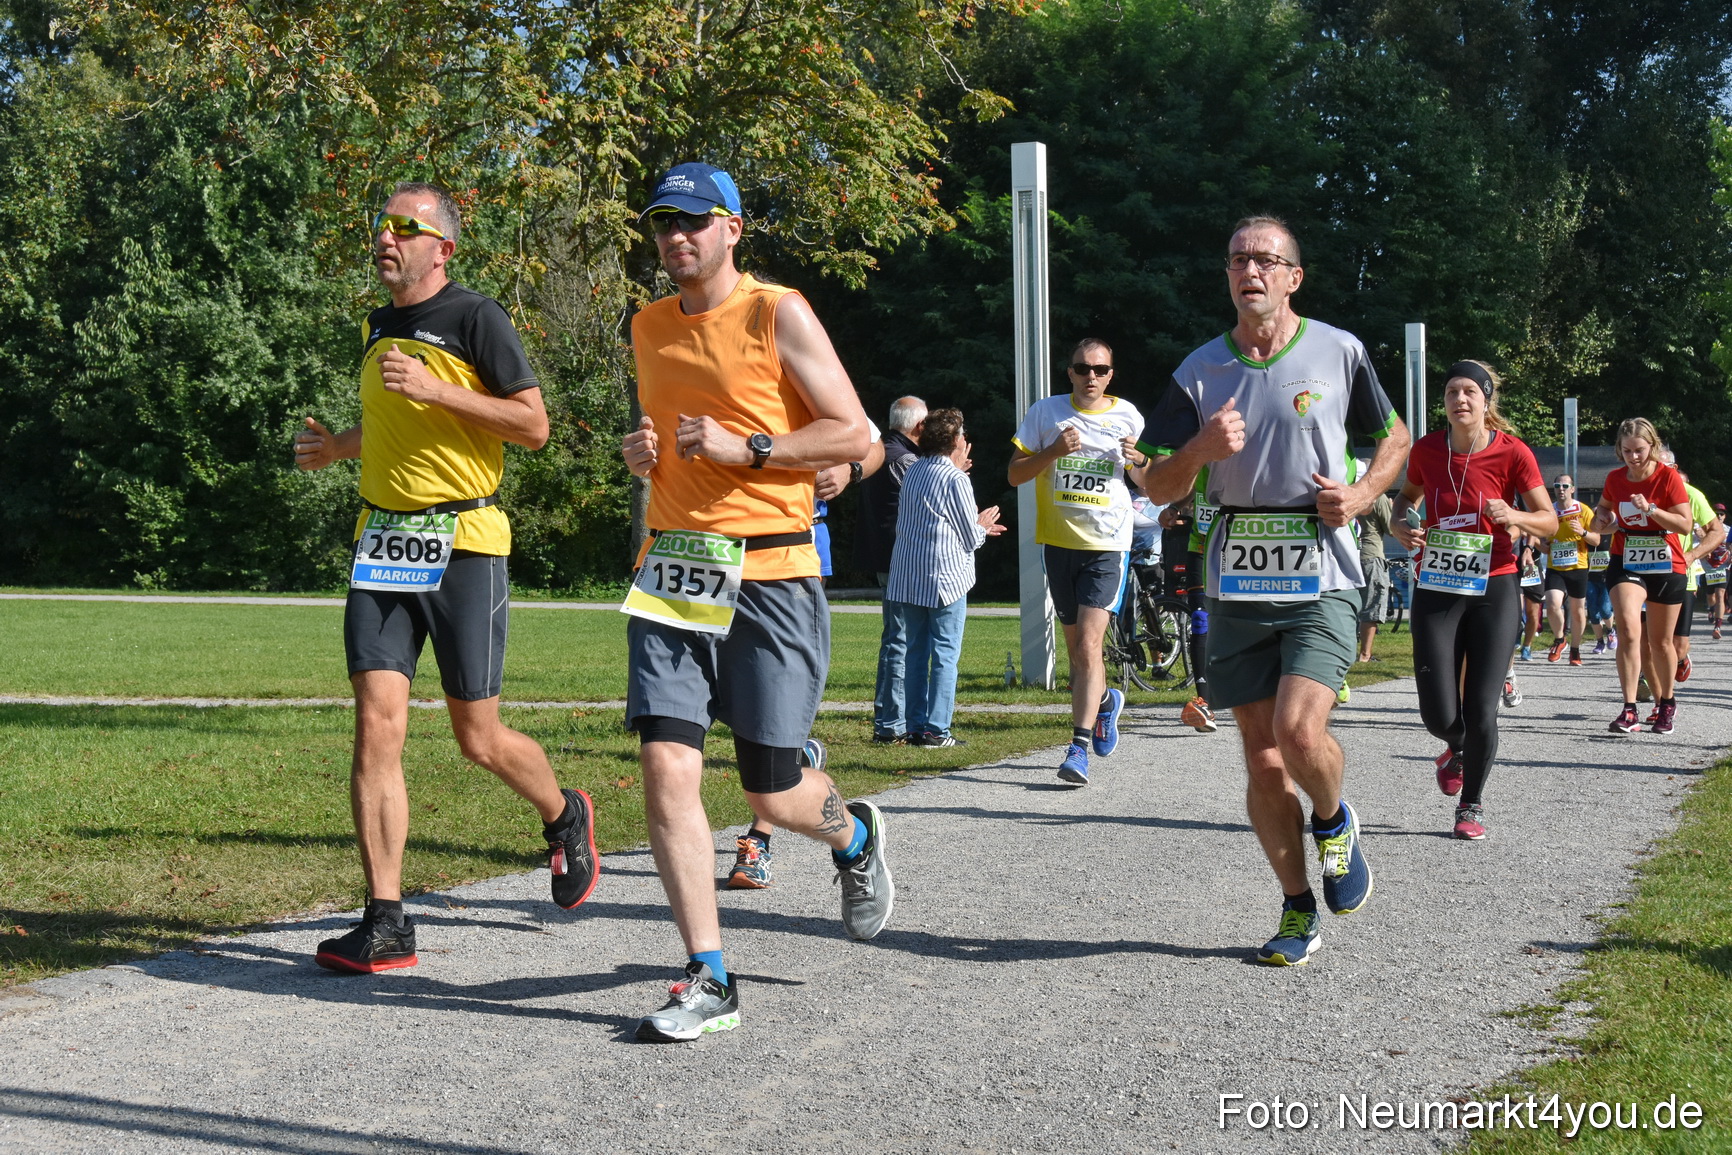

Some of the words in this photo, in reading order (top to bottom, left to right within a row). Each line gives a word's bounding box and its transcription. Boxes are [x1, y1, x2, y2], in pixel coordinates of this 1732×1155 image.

[1061, 457, 1111, 474] BOCK
[1062, 474, 1106, 493] 1205
[1062, 494, 1101, 505] MICHAEL
[1230, 517, 1311, 537] BOCK
[368, 534, 442, 563] 2608
[653, 533, 733, 562] BOCK
[1429, 531, 1486, 551] BOCK
[1628, 538, 1667, 547] BOCK
[1231, 545, 1307, 571] 2017
[1427, 551, 1480, 574] 2564
[1553, 550, 1575, 559] 2386
[1629, 549, 1667, 562] 2716
[370, 568, 430, 583] MARKUS
[653, 562, 727, 599] 1357
[1428, 574, 1476, 588] RAPHAEL
[1237, 579, 1302, 592] WERNER
